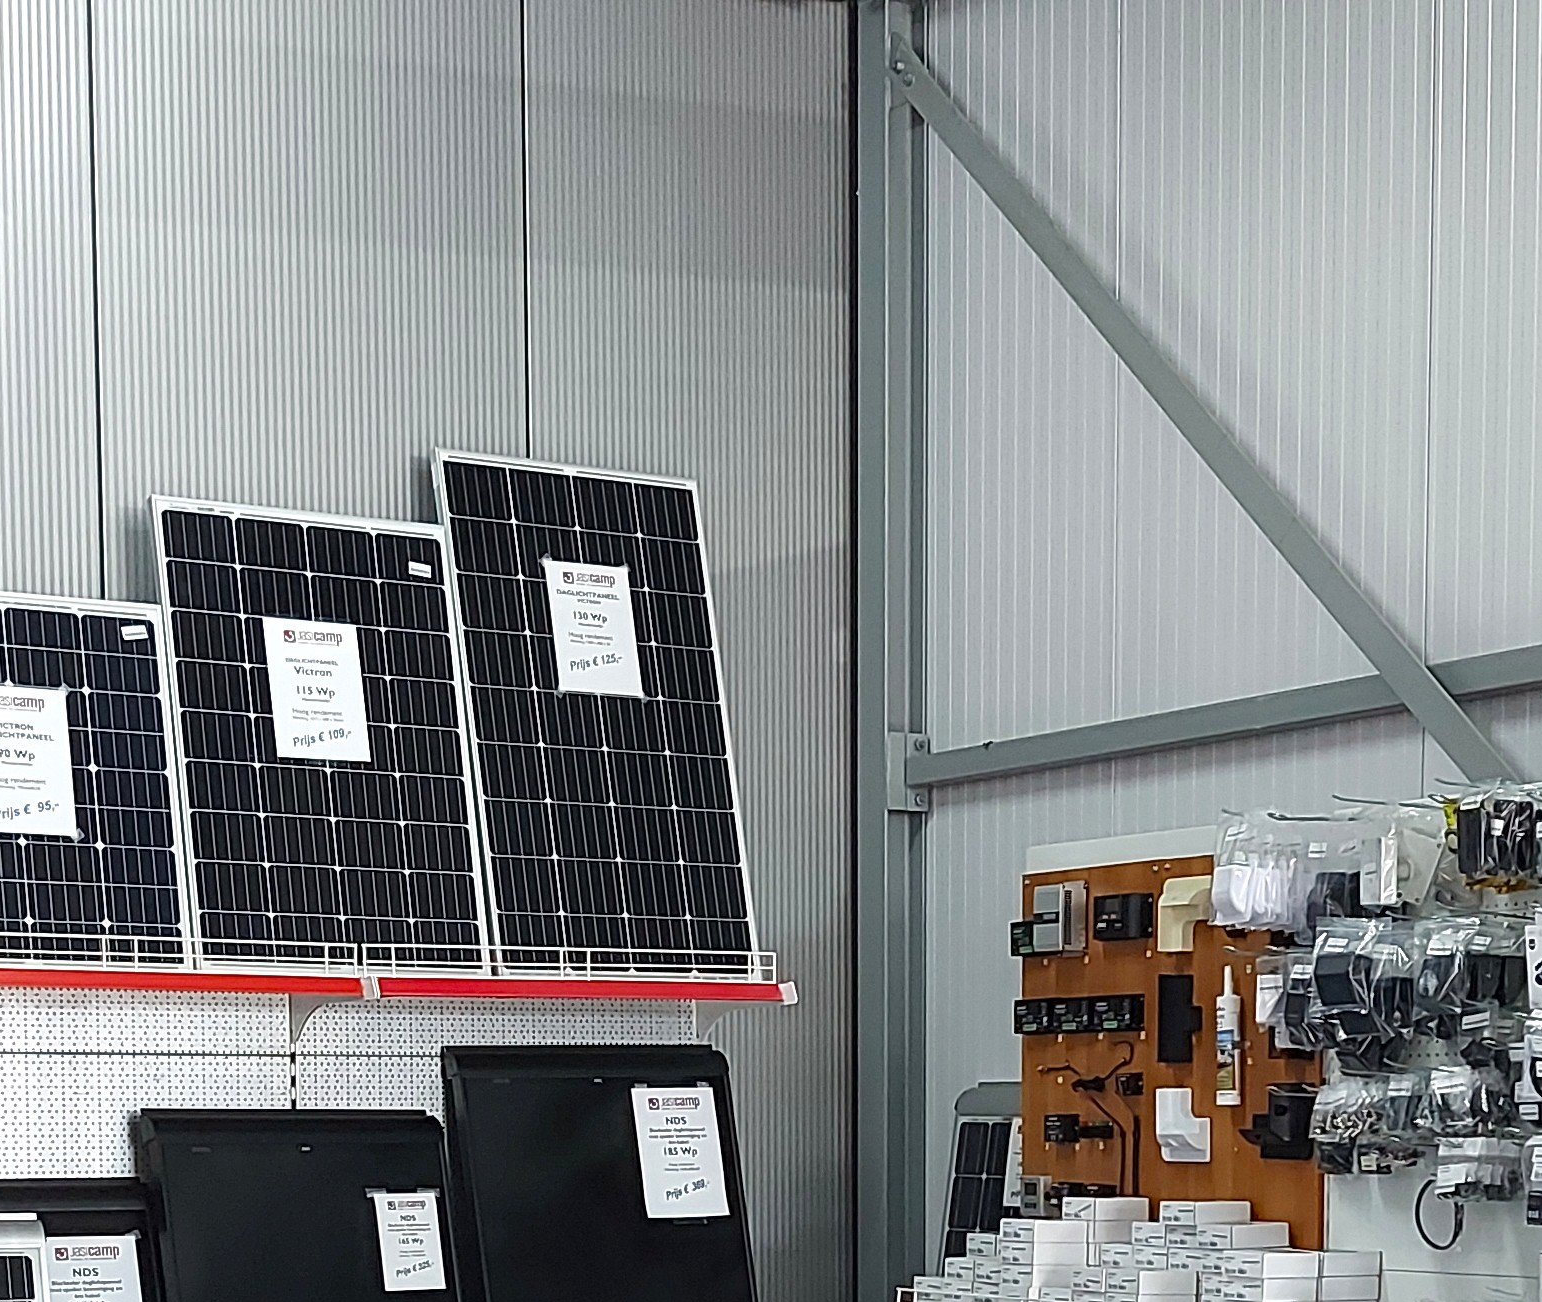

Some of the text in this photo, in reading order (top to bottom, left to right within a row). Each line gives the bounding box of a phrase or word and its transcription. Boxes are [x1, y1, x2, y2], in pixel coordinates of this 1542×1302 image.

[590, 614, 607, 623] Wp
[570, 654, 622, 671] Prijs € 125,-
[294, 666, 332, 676] Victron
[297, 686, 335, 698] 115 Wp
[293, 735, 316, 747] Prijs
[319, 732, 324, 741] €
[14, 750, 35, 761] Wp
[24, 804, 31, 814] €
[666, 1117, 687, 1125] NDS
[681, 1147, 697, 1157] Wp
[73, 1268, 99, 1277] NDS
